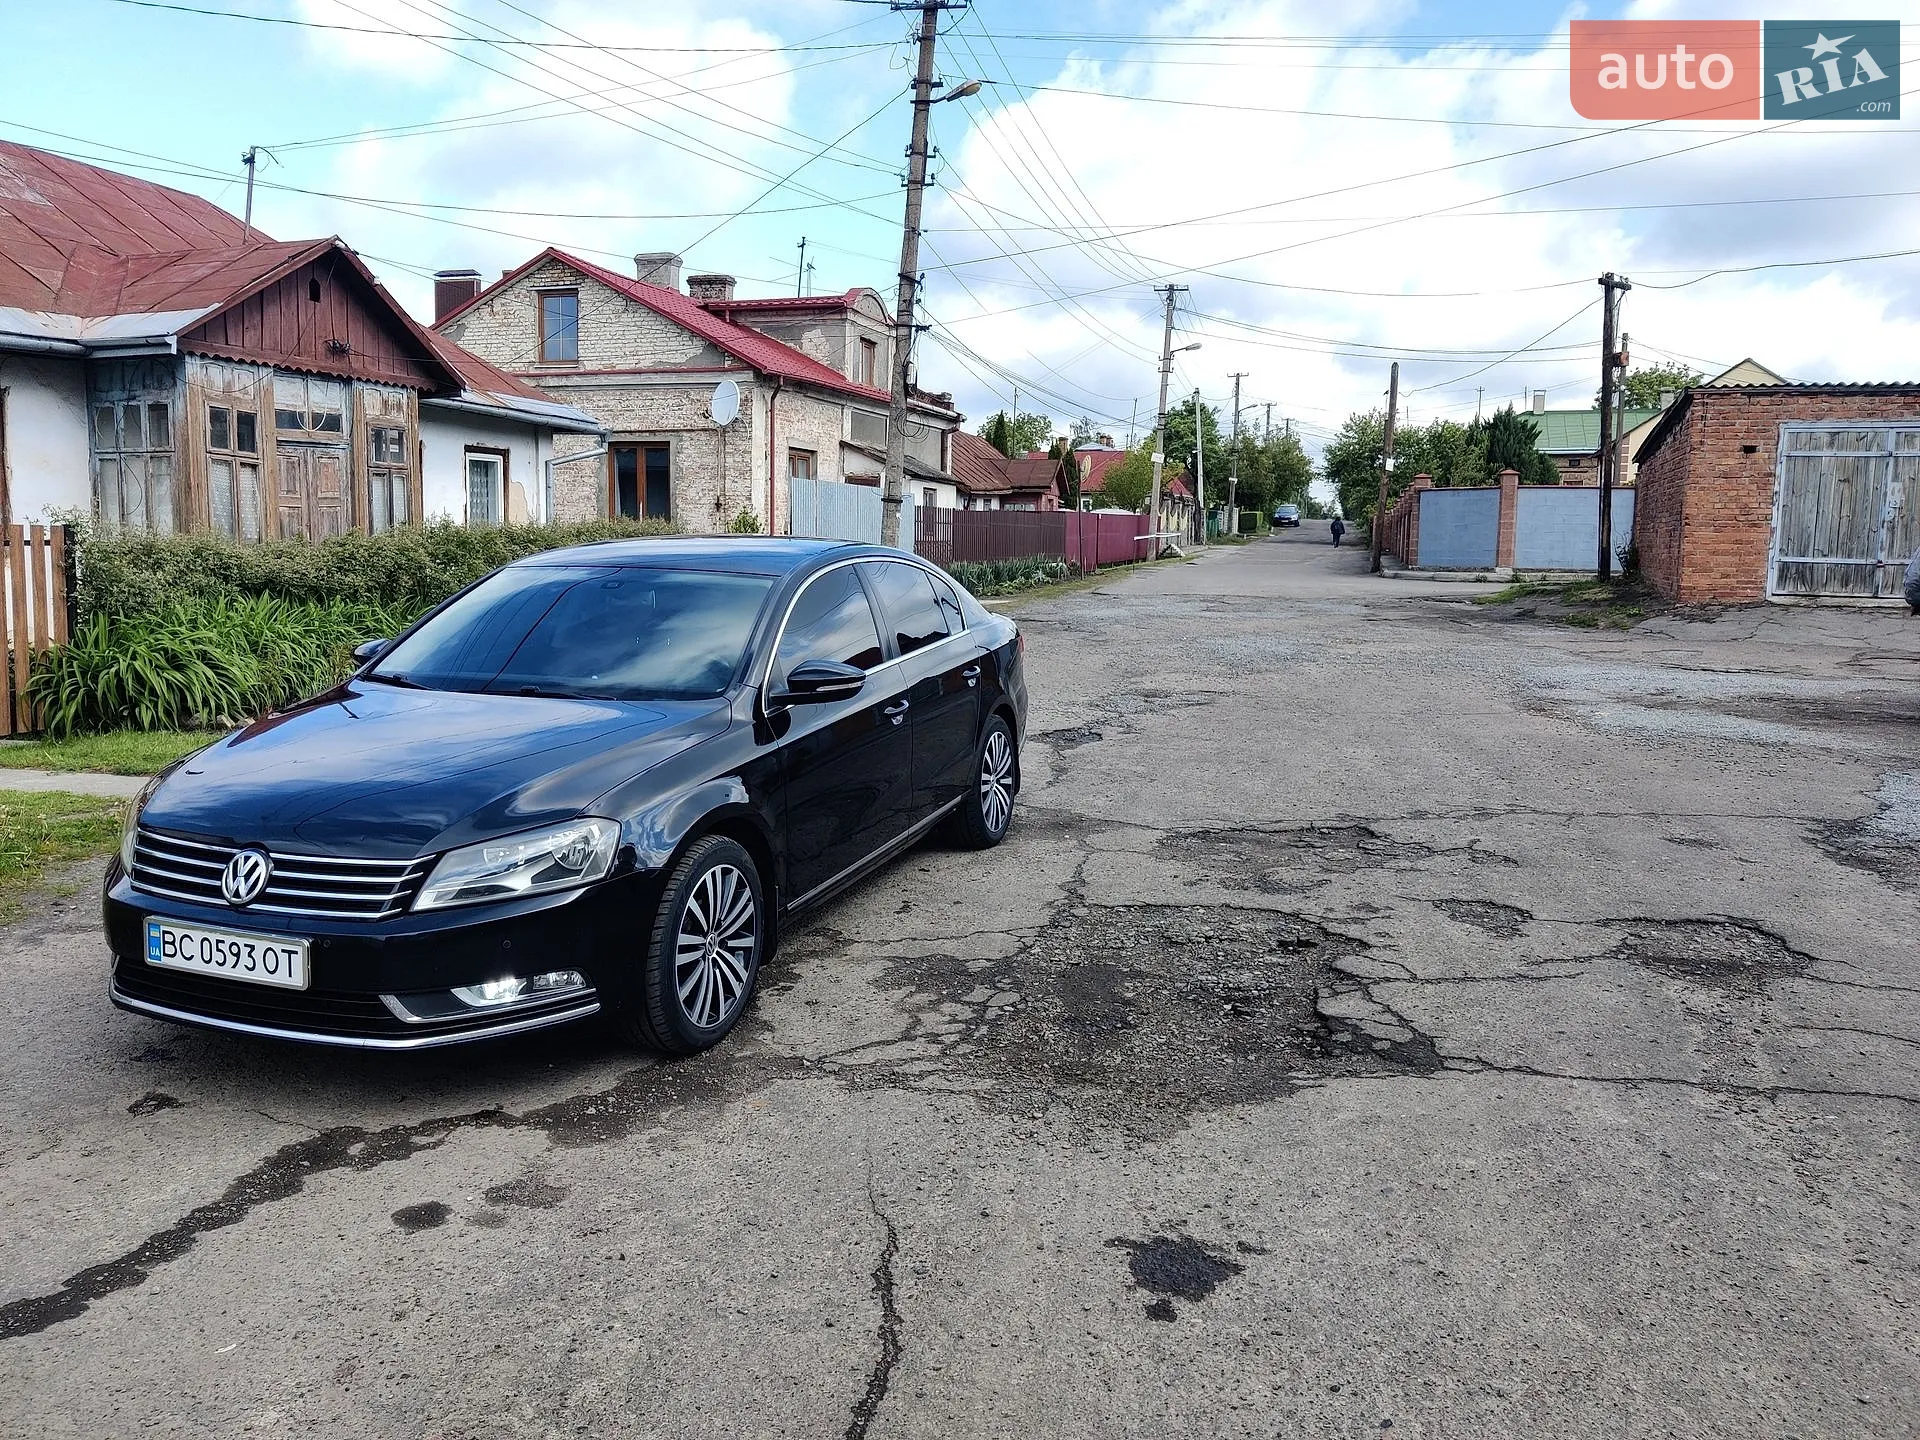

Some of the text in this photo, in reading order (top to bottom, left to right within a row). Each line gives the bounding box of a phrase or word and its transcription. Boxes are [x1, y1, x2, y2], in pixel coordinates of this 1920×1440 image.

[223, 851, 267, 904] VW
[150, 946, 161, 957] UA
[162, 930, 299, 978] BC 0593 OT
